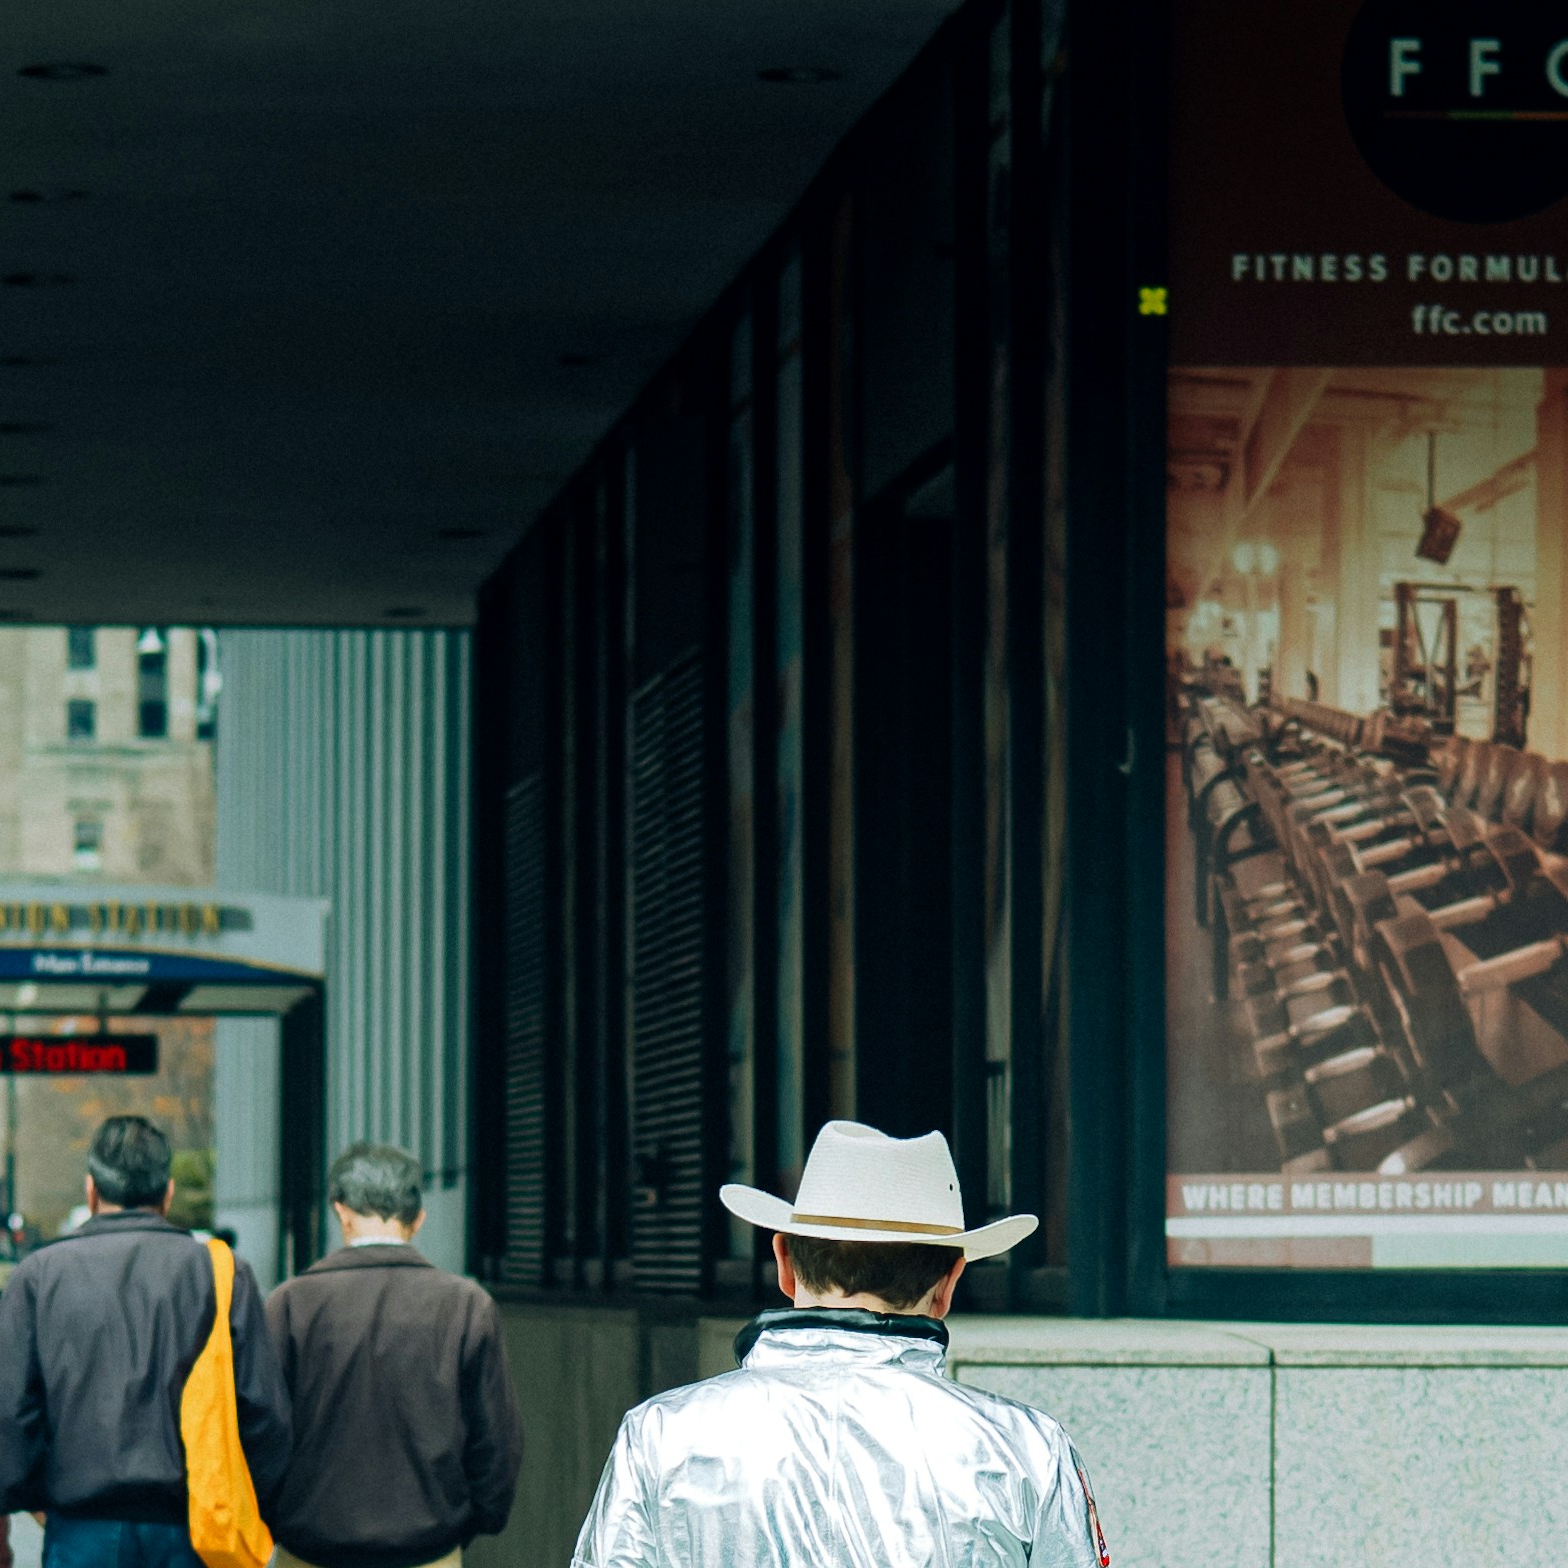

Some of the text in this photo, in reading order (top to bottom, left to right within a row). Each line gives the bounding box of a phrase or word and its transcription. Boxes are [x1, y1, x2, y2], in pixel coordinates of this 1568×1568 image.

[1233, 254, 1388, 282] FITNESS
[1411, 304, 1548, 335] ffc.com
[88, 900, 221, 936] STATION
[10, 1037, 127, 1072] Station
[1182, 1184, 1283, 1210] WHERE
[1291, 1182, 1482, 1209] MEMBERSHIP
